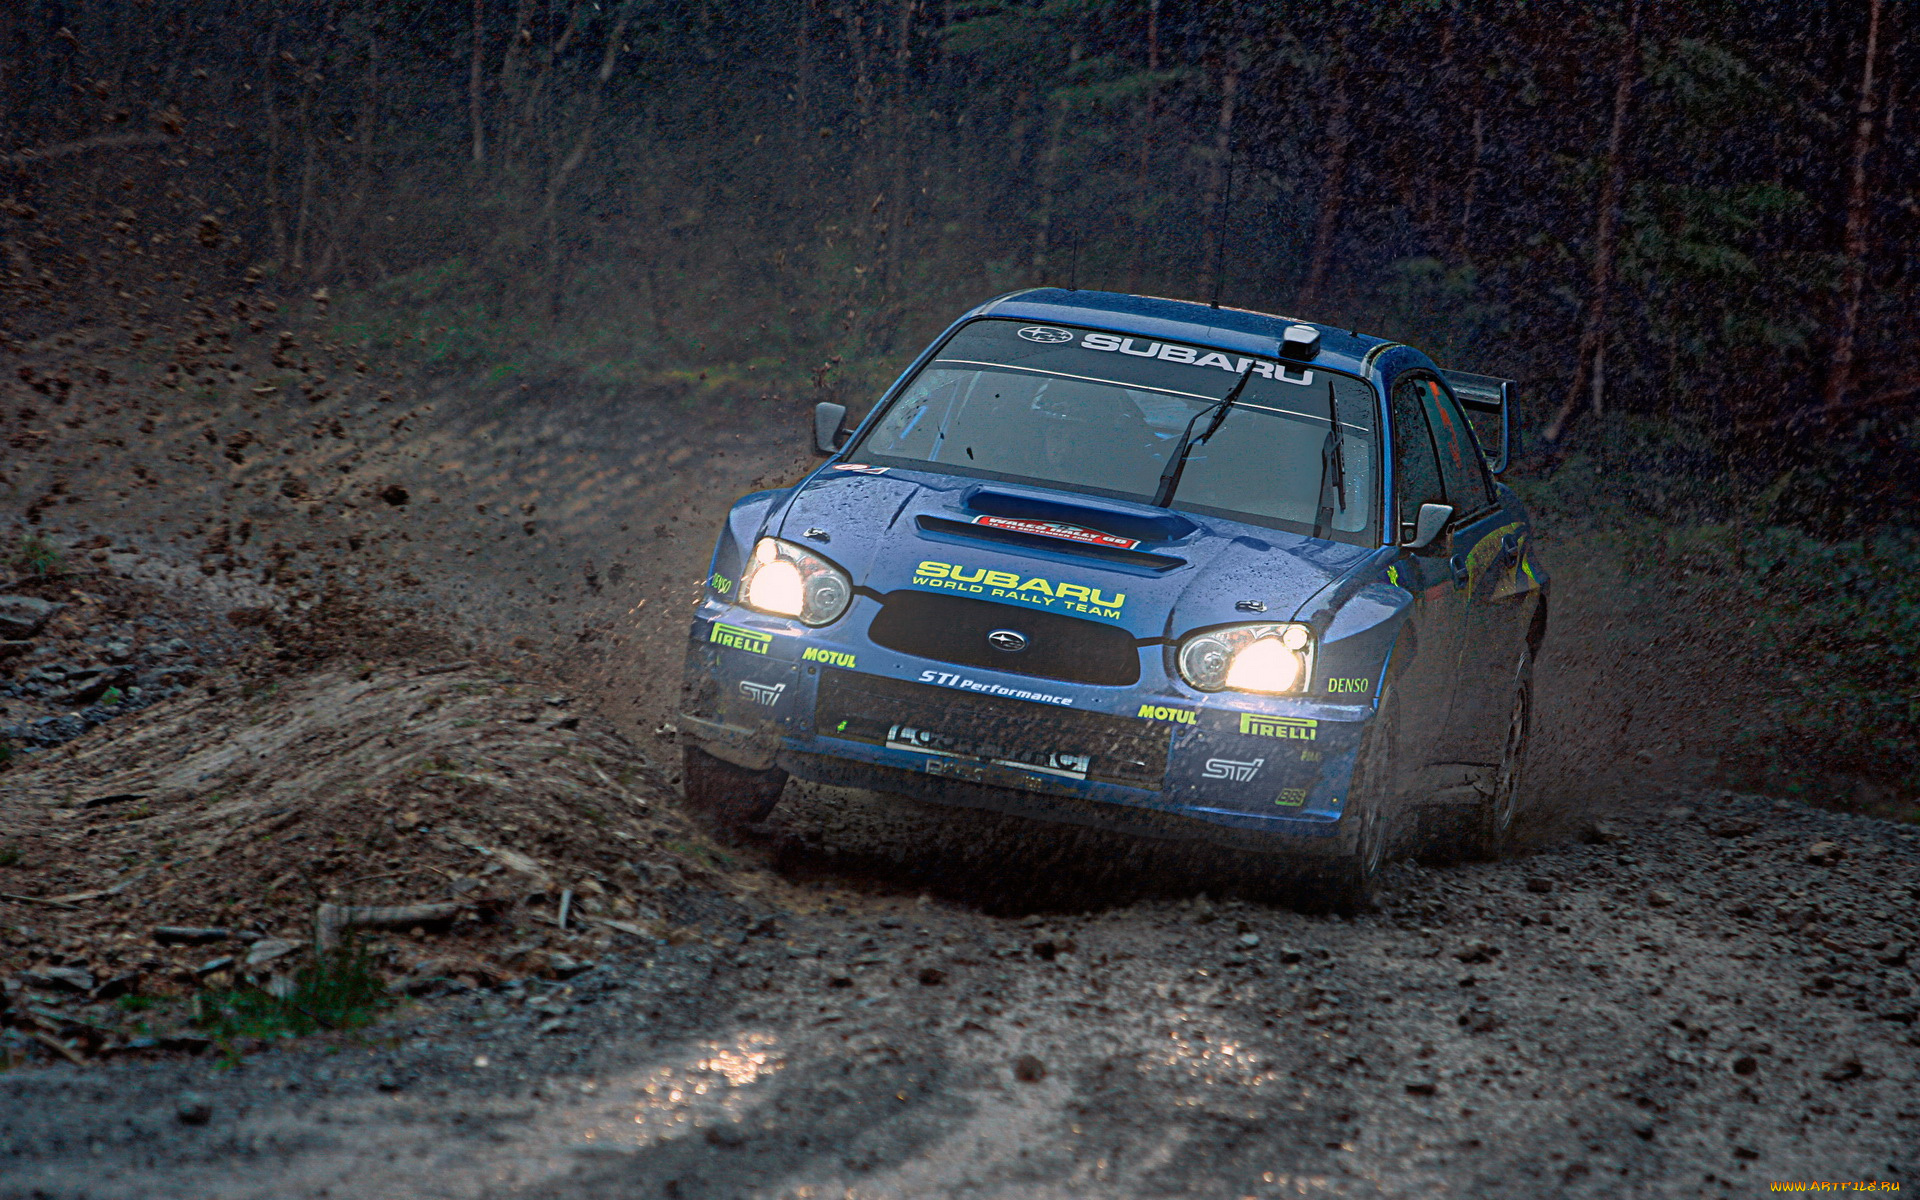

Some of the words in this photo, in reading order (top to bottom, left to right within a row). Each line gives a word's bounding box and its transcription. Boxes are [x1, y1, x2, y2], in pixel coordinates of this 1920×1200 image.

[1080, 332, 1313, 387] SUBARU
[988, 518, 1047, 530] WALES
[1050, 528, 1100, 540] RALLY
[912, 576, 983, 593] WORLD
[991, 588, 1056, 606] RALLY
[1063, 600, 1120, 620] TEAM
[915, 560, 1126, 608] SUBARU
[710, 622, 773, 655] PIRELLI
[802, 647, 856, 668] MOTUL
[918, 670, 960, 687] STI
[960, 679, 1073, 706] Performance
[1328, 678, 1369, 693] DENSO
[1137, 704, 1198, 725] MOTUL
[1239, 712, 1318, 741] PIRELLI
